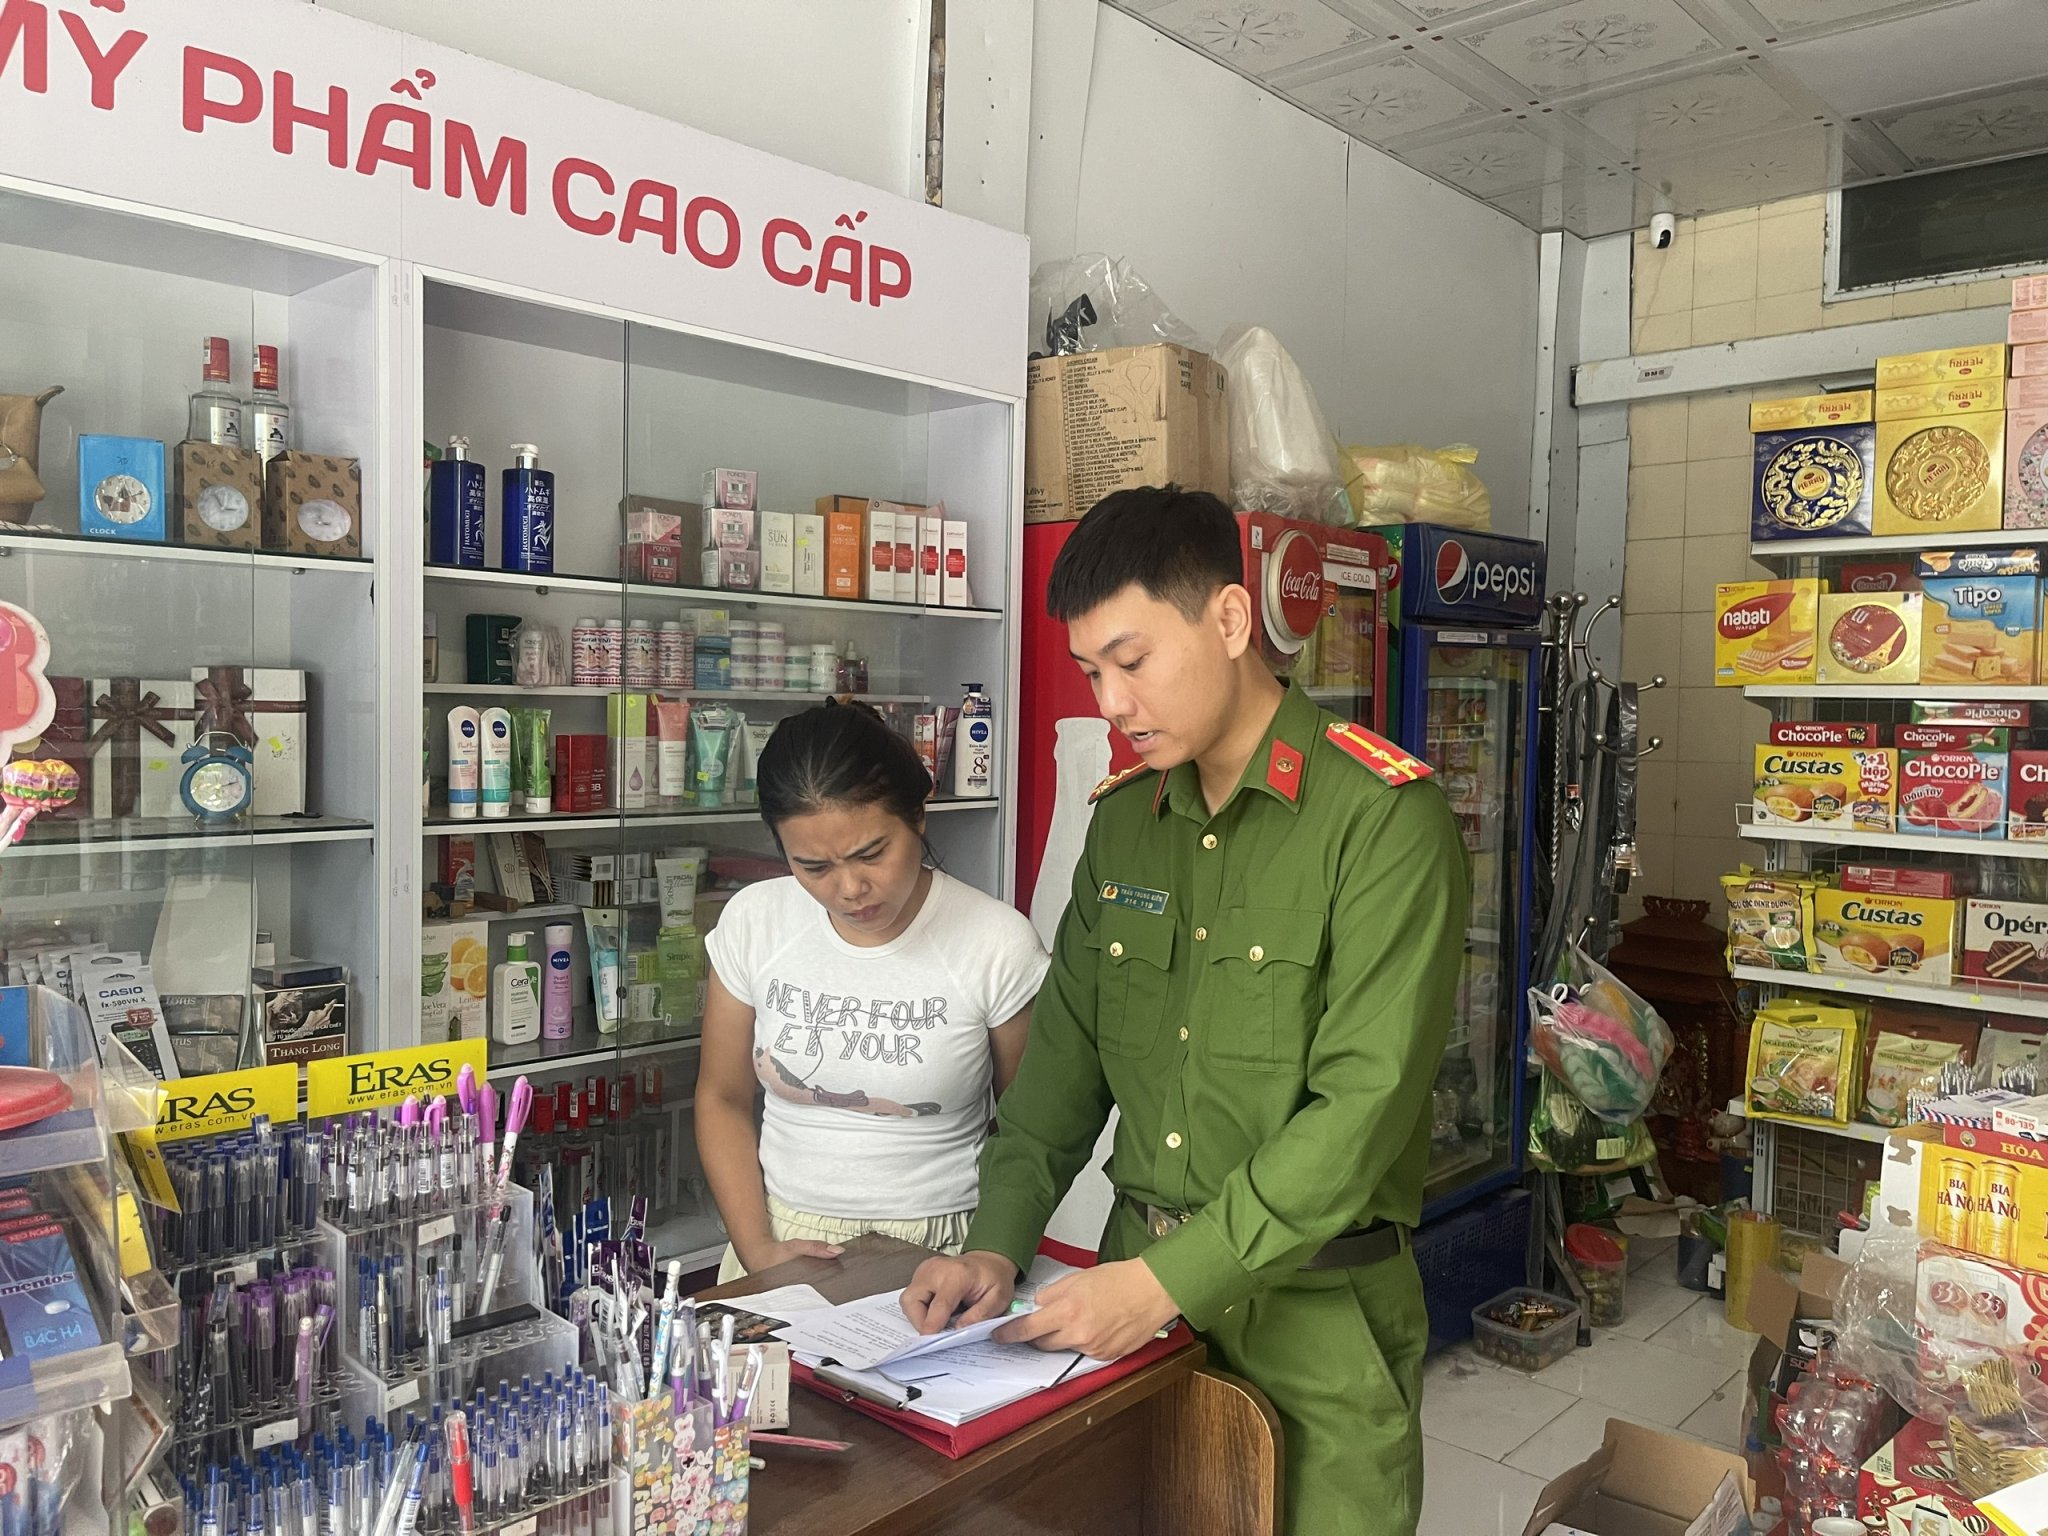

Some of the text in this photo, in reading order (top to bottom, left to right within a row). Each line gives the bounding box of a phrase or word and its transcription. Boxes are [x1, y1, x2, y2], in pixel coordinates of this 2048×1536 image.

[181, 69, 529, 216] PHẨM
[551, 157, 741, 269] CAO
[761, 210, 913, 308] CẤP
[1948, 356, 1983, 369] MERRY
[1947, 389, 1983, 402] MERRY
[1818, 402, 1852, 415] MERRY
[89, 526, 117, 535] CLOCK
[767, 532, 788, 544] SUN
[1341, 571, 1371, 584] ICE COLD
[1472, 561, 1537, 602] pepsi
[1953, 586, 2002, 609] Tipo
[1723, 608, 1770, 627] nabati
[1965, 707, 2021, 720] ChocoPie
[1777, 728, 1843, 743] ChocoPie
[1903, 730, 1956, 743] ChocoPie
[1763, 755, 1844, 776] Custas
[1866, 752, 1886, 766] +1
[1941, 754, 1974, 763] ORION
[1862, 765, 1889, 779] Hộp
[1904, 759, 1999, 781] ChocoPie
[1874, 898, 1903, 907] ORION
[1841, 901, 1924, 927] Custas
[1984, 912, 2048, 937] Opér
[511, 975, 538, 988] CeraVe
[99, 985, 144, 999] CASIO
[421, 1002, 432, 1010] loe
[765, 978, 948, 1031] NEVER FOUR
[311, 1042, 341, 1053] LONG
[839, 1030, 924, 1066] YOUR
[347, 1058, 453, 1097] ERAS
[346, 1080, 453, 1106] www.eras.com.vn
[154, 1110, 257, 1135] w.eras.com.vn
[2000, 1140, 2044, 1161] HÒA
[1949, 1178, 1968, 1191] BIA
[1990, 1183, 2011, 1197] BIA
[1937, 1188, 1953, 1207] HÀ
[1977, 1194, 1995, 1214] HÀ
[0, 1271, 76, 1298] mentos
[60, 1320, 83, 1340] HÀ
